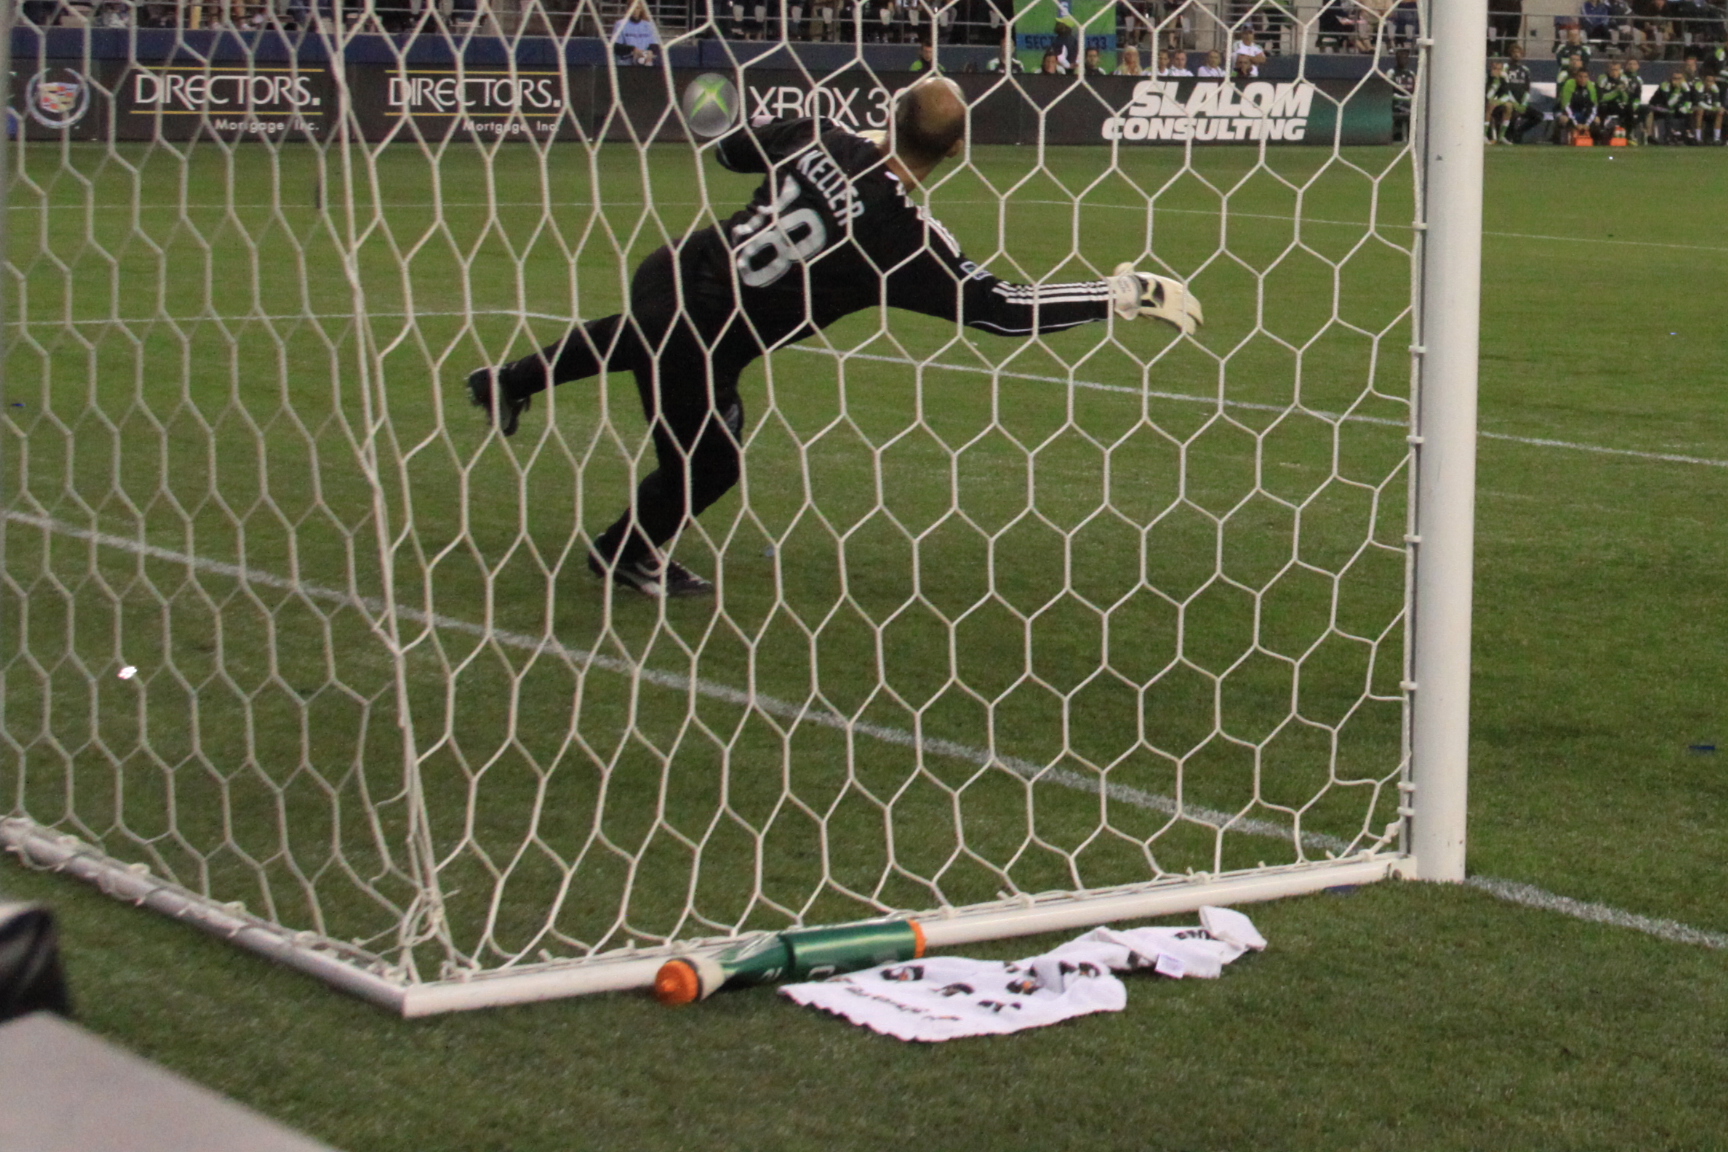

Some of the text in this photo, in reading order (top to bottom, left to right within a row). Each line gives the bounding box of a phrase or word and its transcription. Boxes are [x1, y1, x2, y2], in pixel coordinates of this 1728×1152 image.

[750, 86, 860, 127] XBOX
[1128, 80, 1316, 117] SLALOM
[215, 118, 286, 134] Mortgage
[1101, 116, 1307, 141] CONSULTING
[796, 149, 866, 227] KELLER
